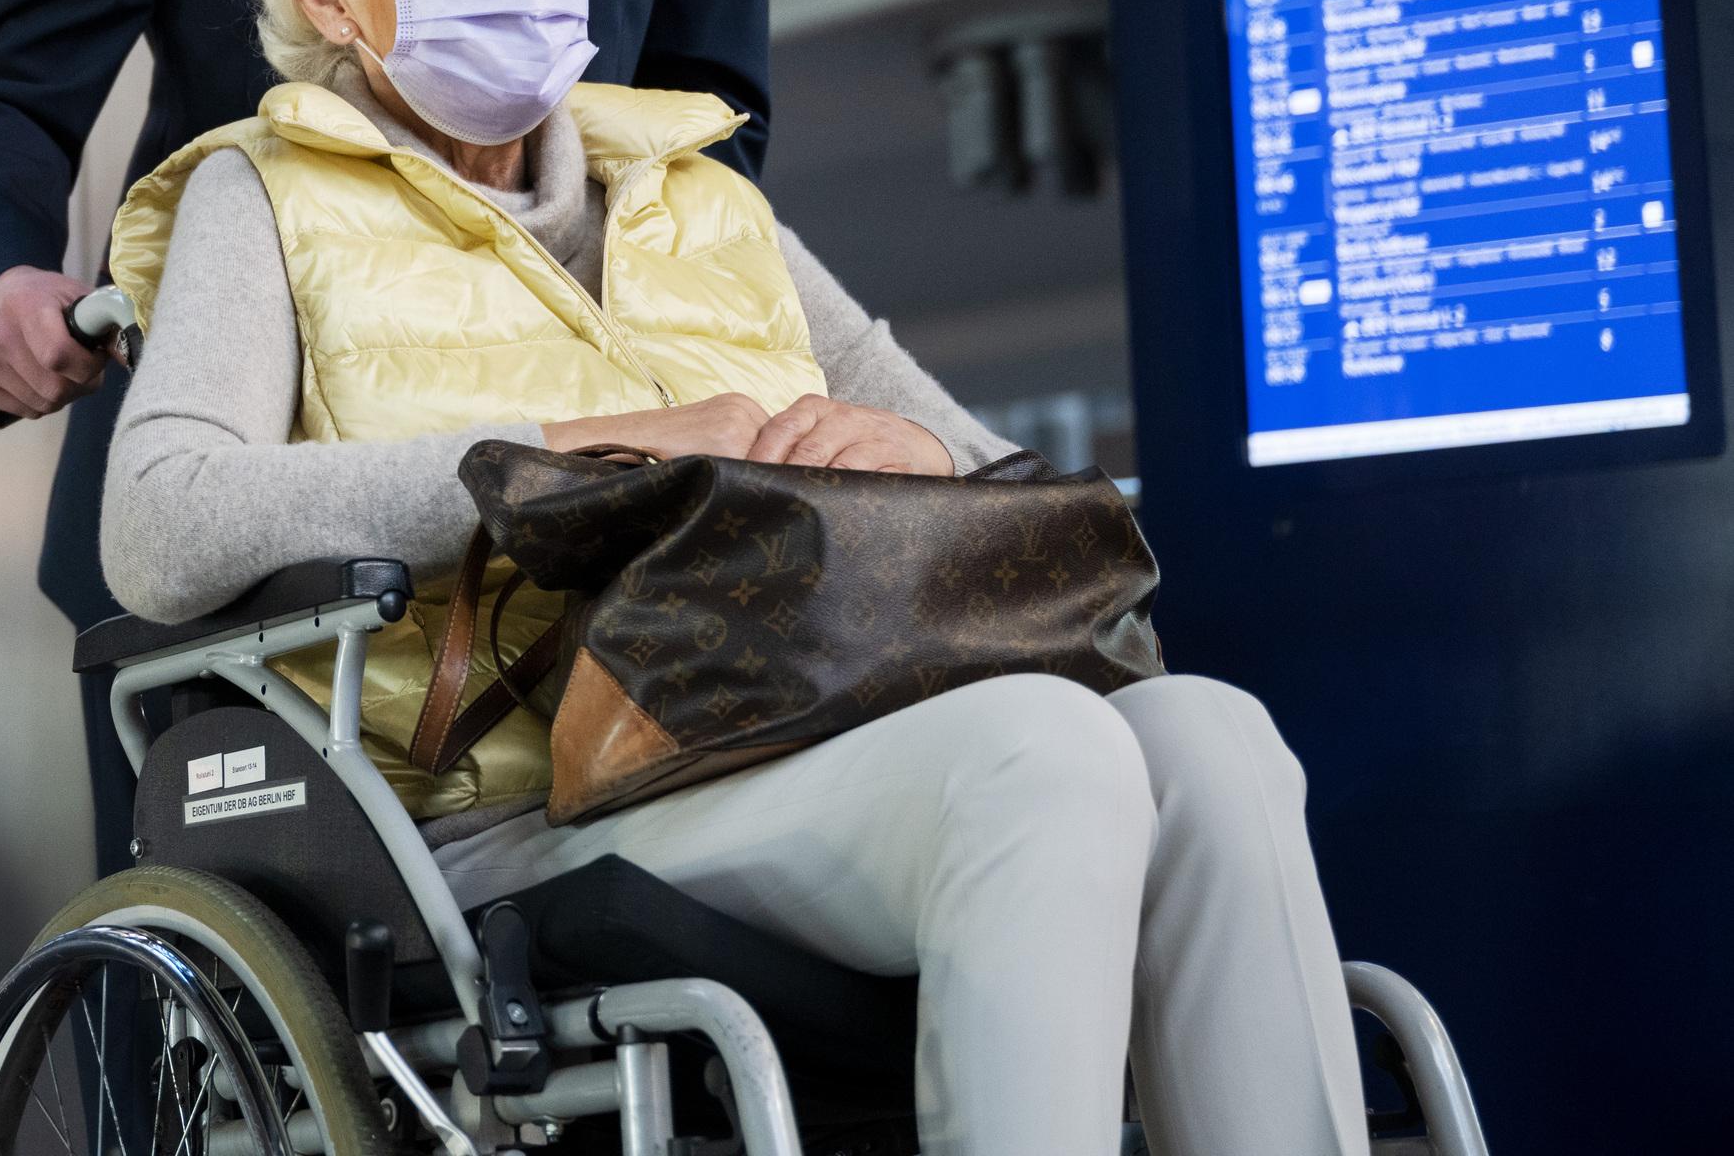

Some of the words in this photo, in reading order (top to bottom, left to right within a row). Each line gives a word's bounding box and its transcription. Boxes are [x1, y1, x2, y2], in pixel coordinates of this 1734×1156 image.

[192, 802, 223, 818] EIGENTUM
[224, 800, 237, 813] DER
[238, 798, 248, 811] DB
[248, 795, 258, 808] AG
[258, 791, 282, 807] BERLIN
[283, 788, 296, 802] HBF
